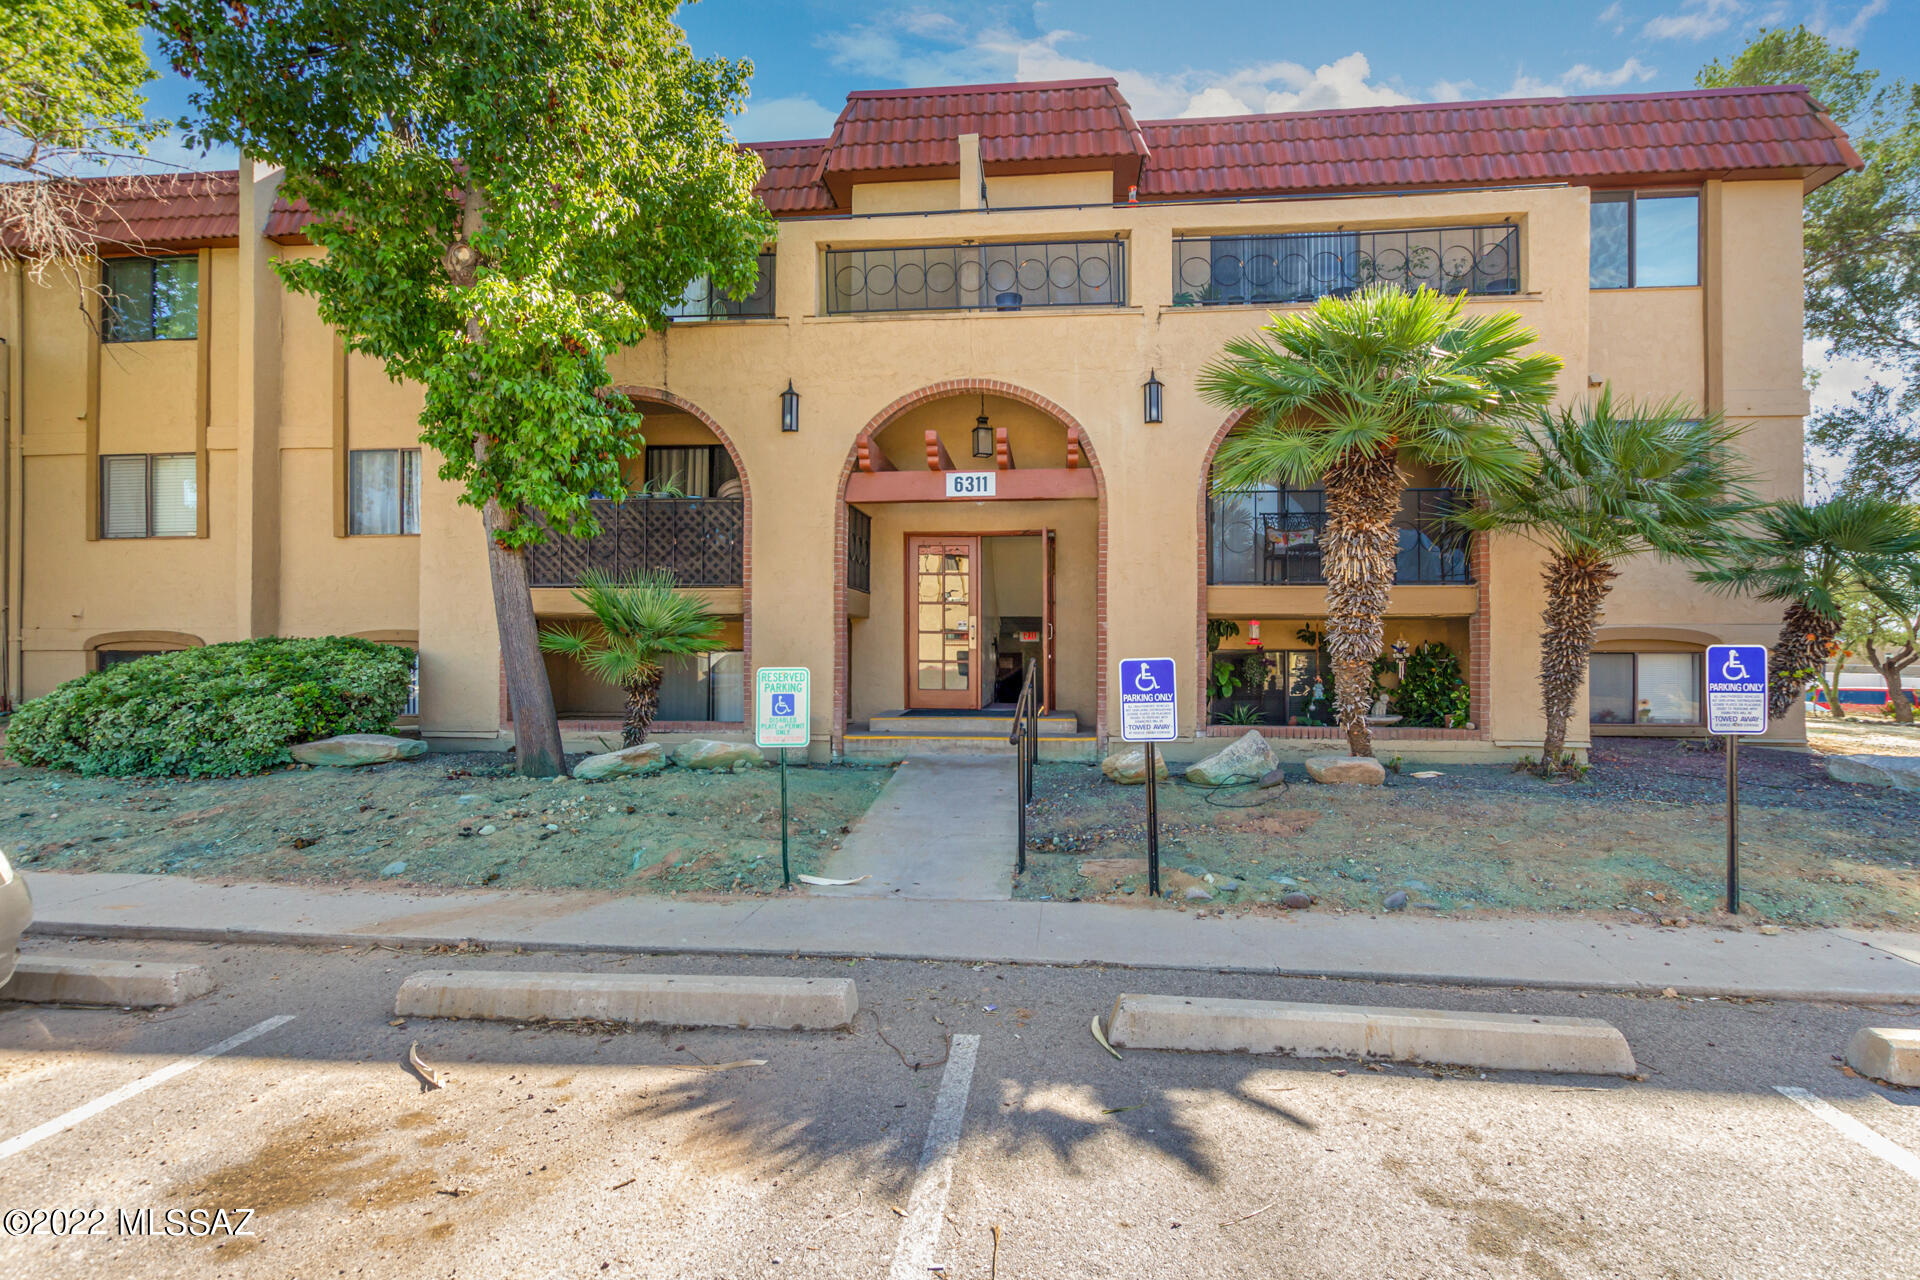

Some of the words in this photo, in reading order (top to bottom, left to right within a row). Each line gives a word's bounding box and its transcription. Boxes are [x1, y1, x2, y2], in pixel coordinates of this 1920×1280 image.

[954, 476, 988, 492] 6311
[761, 672, 806, 682] RESERVED
[763, 683, 803, 693] PARKING
[1709, 683, 1742, 692] PARKING
[1742, 683, 1764, 692] ONLY
[1123, 694, 1154, 702] PARKING
[1154, 693, 1174, 702] ONLY
